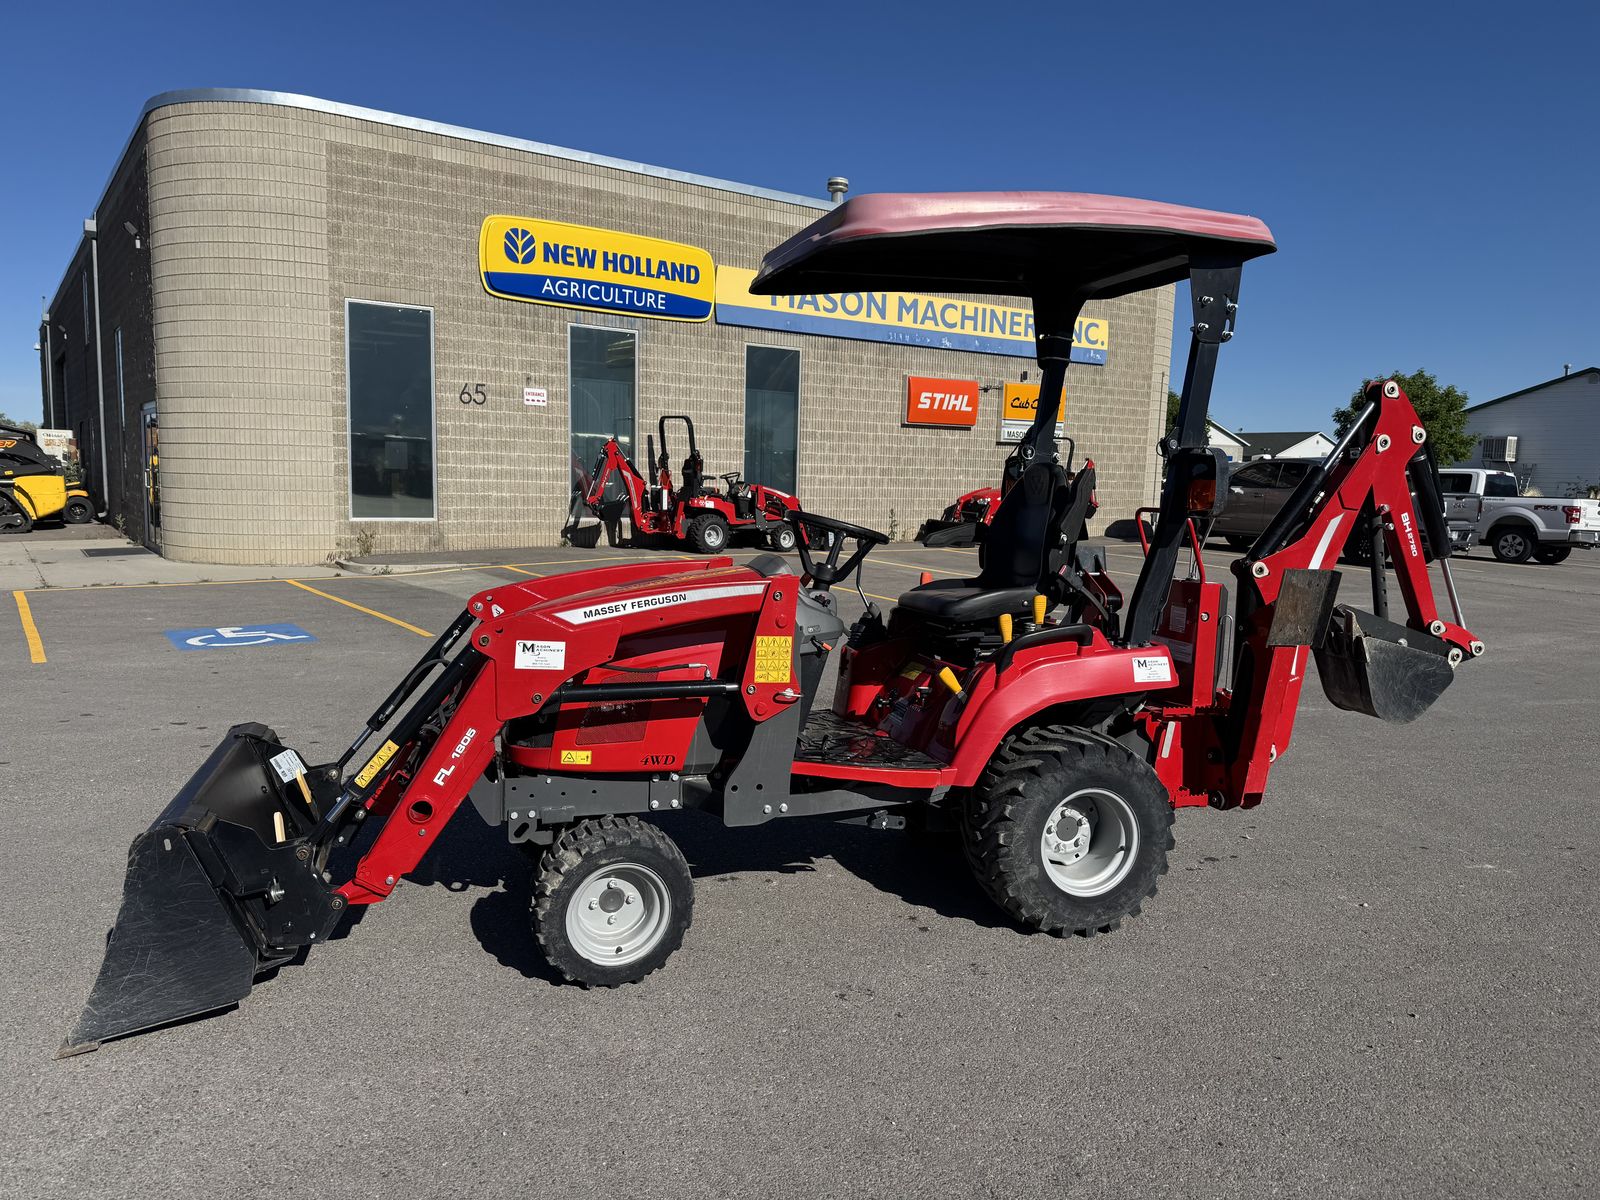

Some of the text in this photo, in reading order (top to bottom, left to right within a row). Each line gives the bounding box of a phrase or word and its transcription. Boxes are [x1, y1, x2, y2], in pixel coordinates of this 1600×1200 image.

[543, 241, 700, 285] NEW HOLLAND
[541, 278, 666, 310] AGRICULTURE
[897, 296, 1036, 337] MACHINER
[1072, 316, 1106, 346] NC.
[459, 383, 487, 405] 65
[917, 391, 973, 412] STIHL
[1010, 396, 1030, 409] Cub
[583, 593, 687, 619] MASSEY FERGUSON
[433, 727, 477, 787] FL 1805
[640, 754, 676, 767] 4WD
